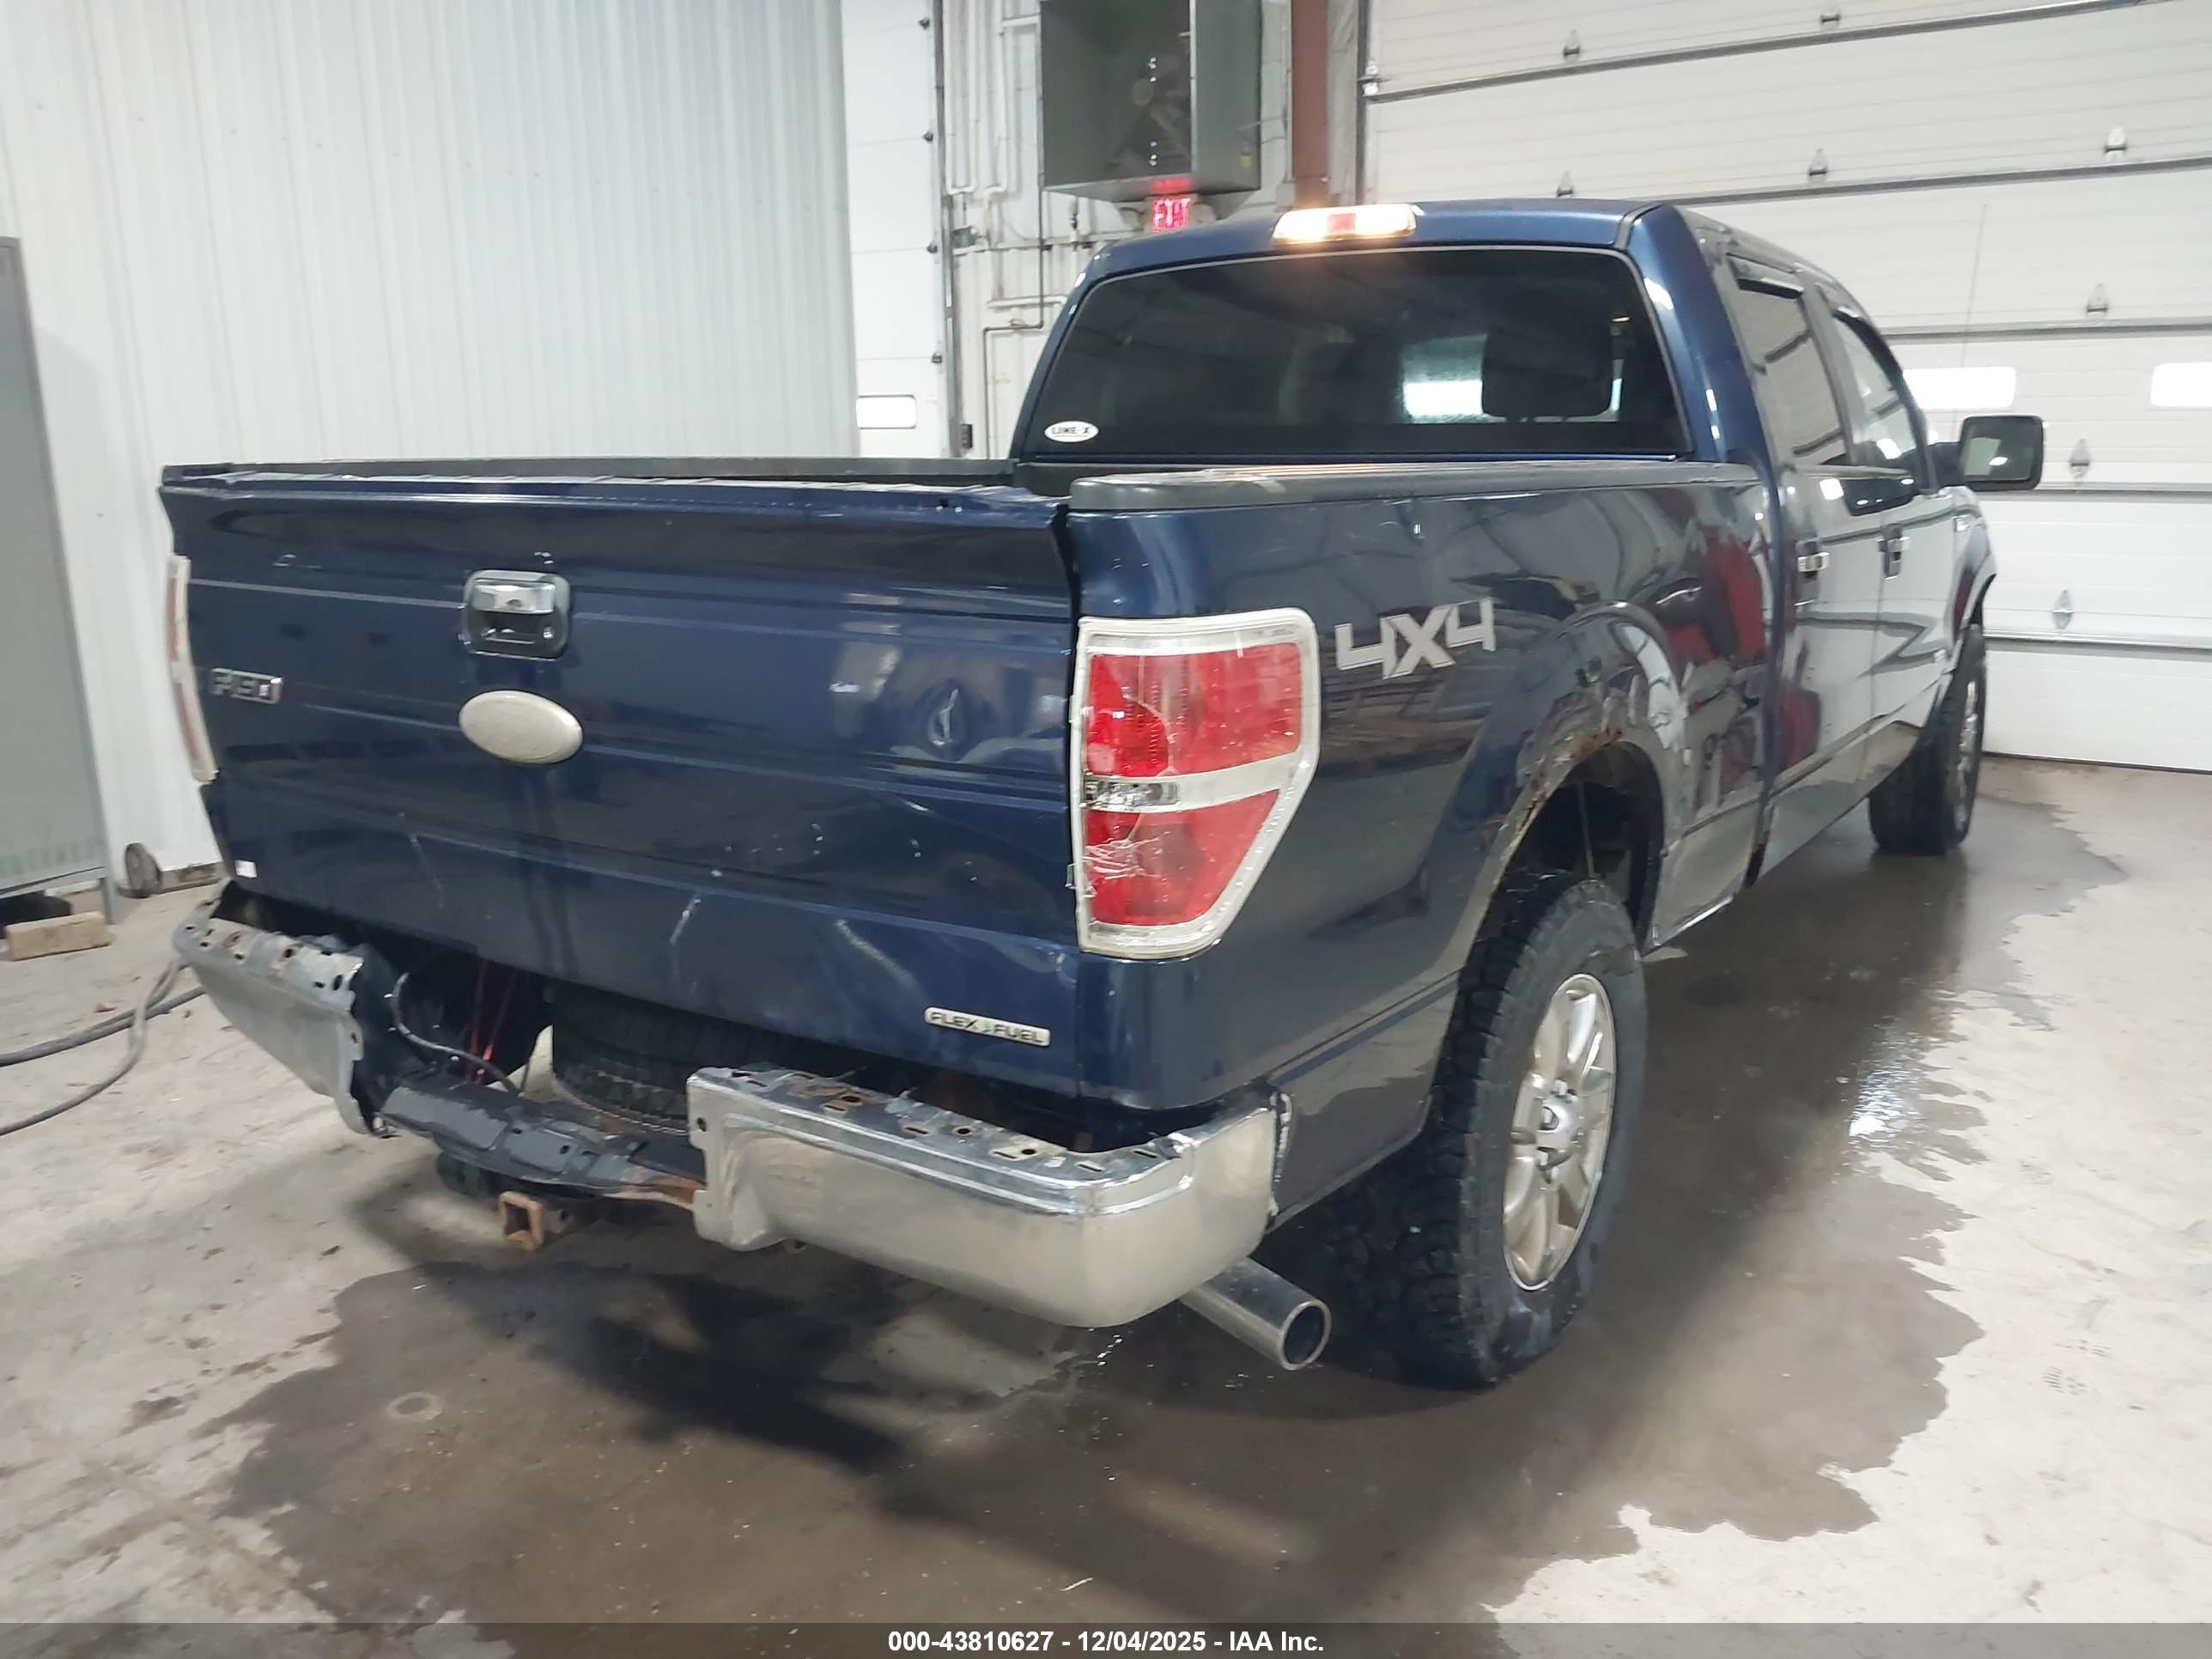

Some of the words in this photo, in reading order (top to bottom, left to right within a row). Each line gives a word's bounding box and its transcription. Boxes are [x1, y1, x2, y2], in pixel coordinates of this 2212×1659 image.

[1334, 597, 1496, 680] 4X4
[930, 1011, 978, 1030] FLEX
[994, 1024, 1043, 1043] FUEL
